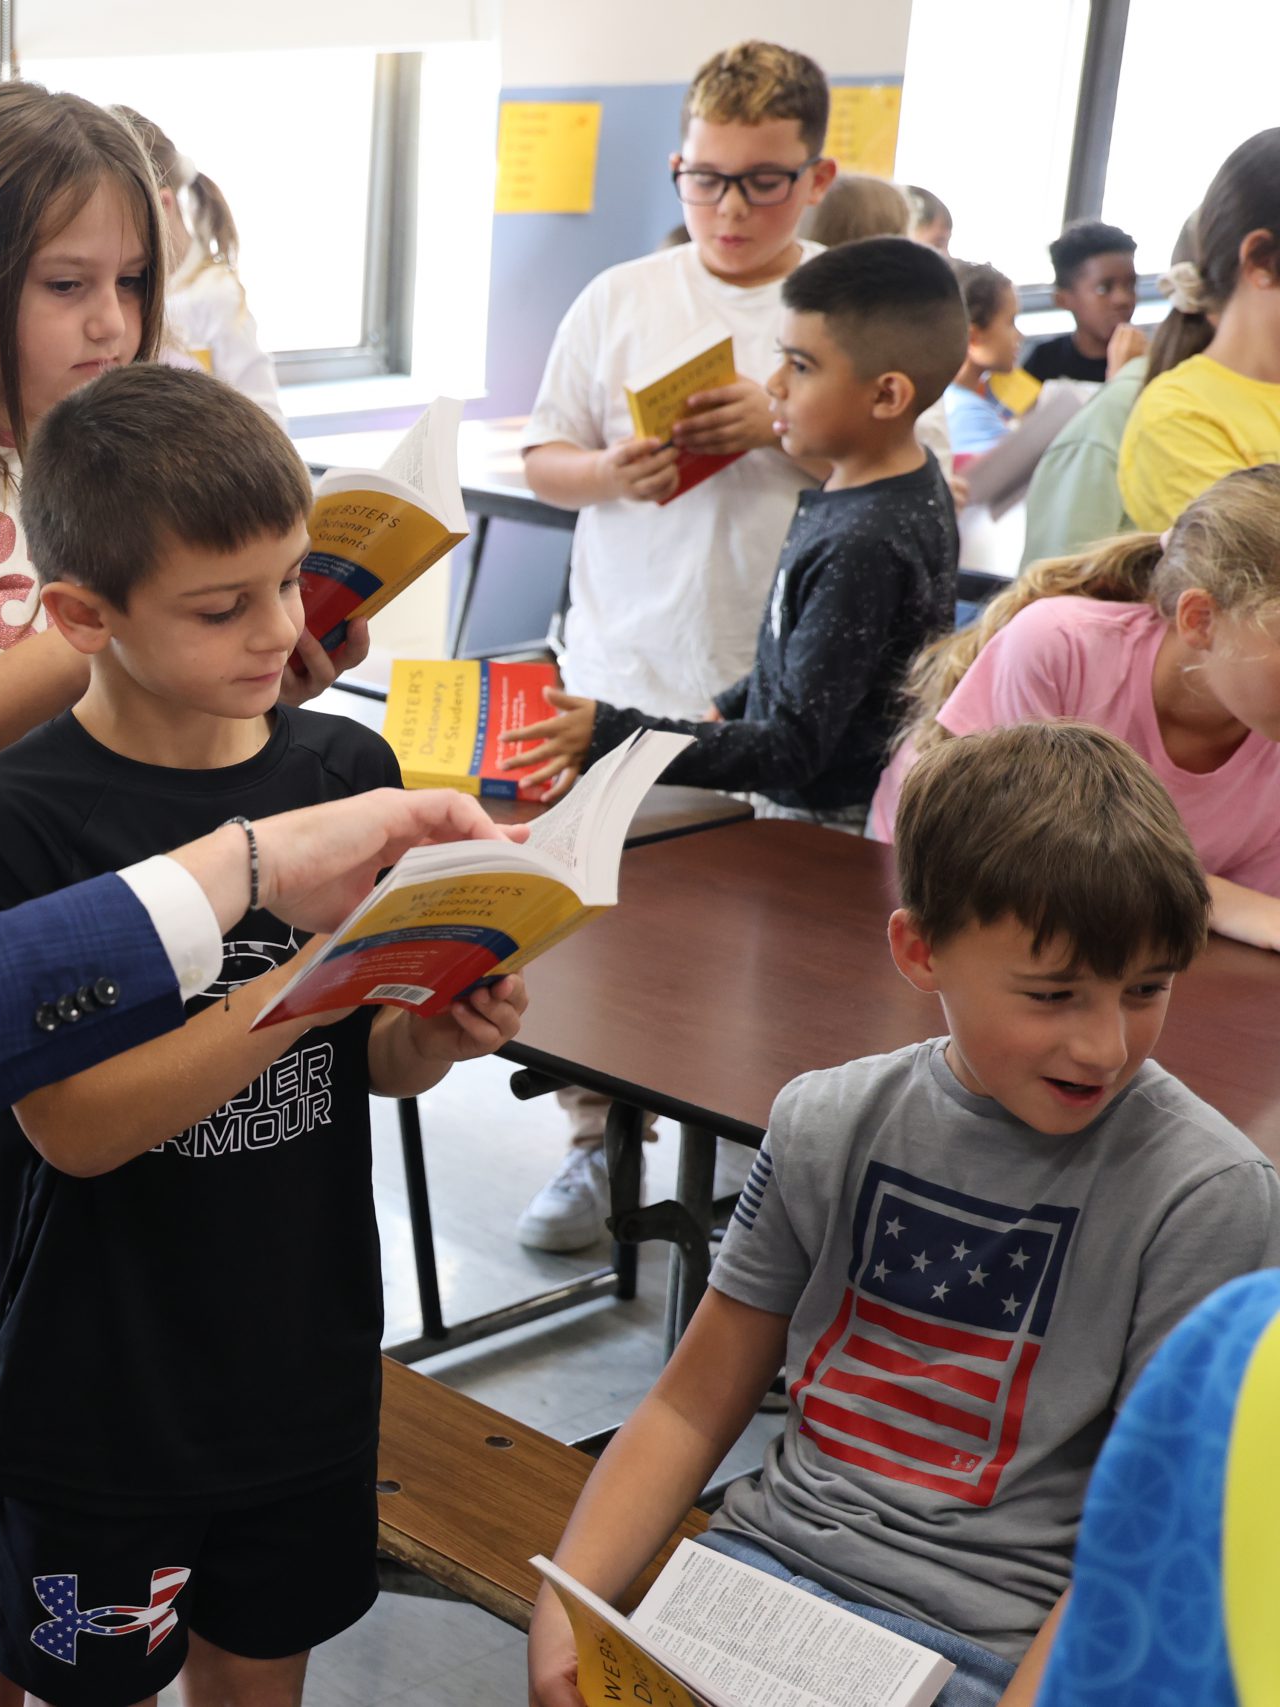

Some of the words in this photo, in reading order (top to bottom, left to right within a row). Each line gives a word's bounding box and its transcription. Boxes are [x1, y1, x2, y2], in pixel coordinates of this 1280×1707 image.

[399, 669, 424, 760] WEBSTER'S
[420, 681, 448, 755] Dictionary
[445, 673, 465, 740] Students
[411, 885, 526, 902] WEBSTER'S
[417, 908, 494, 918] Students
[206, 1042, 334, 1118] DER
[149, 1088, 333, 1158] RMOUR
